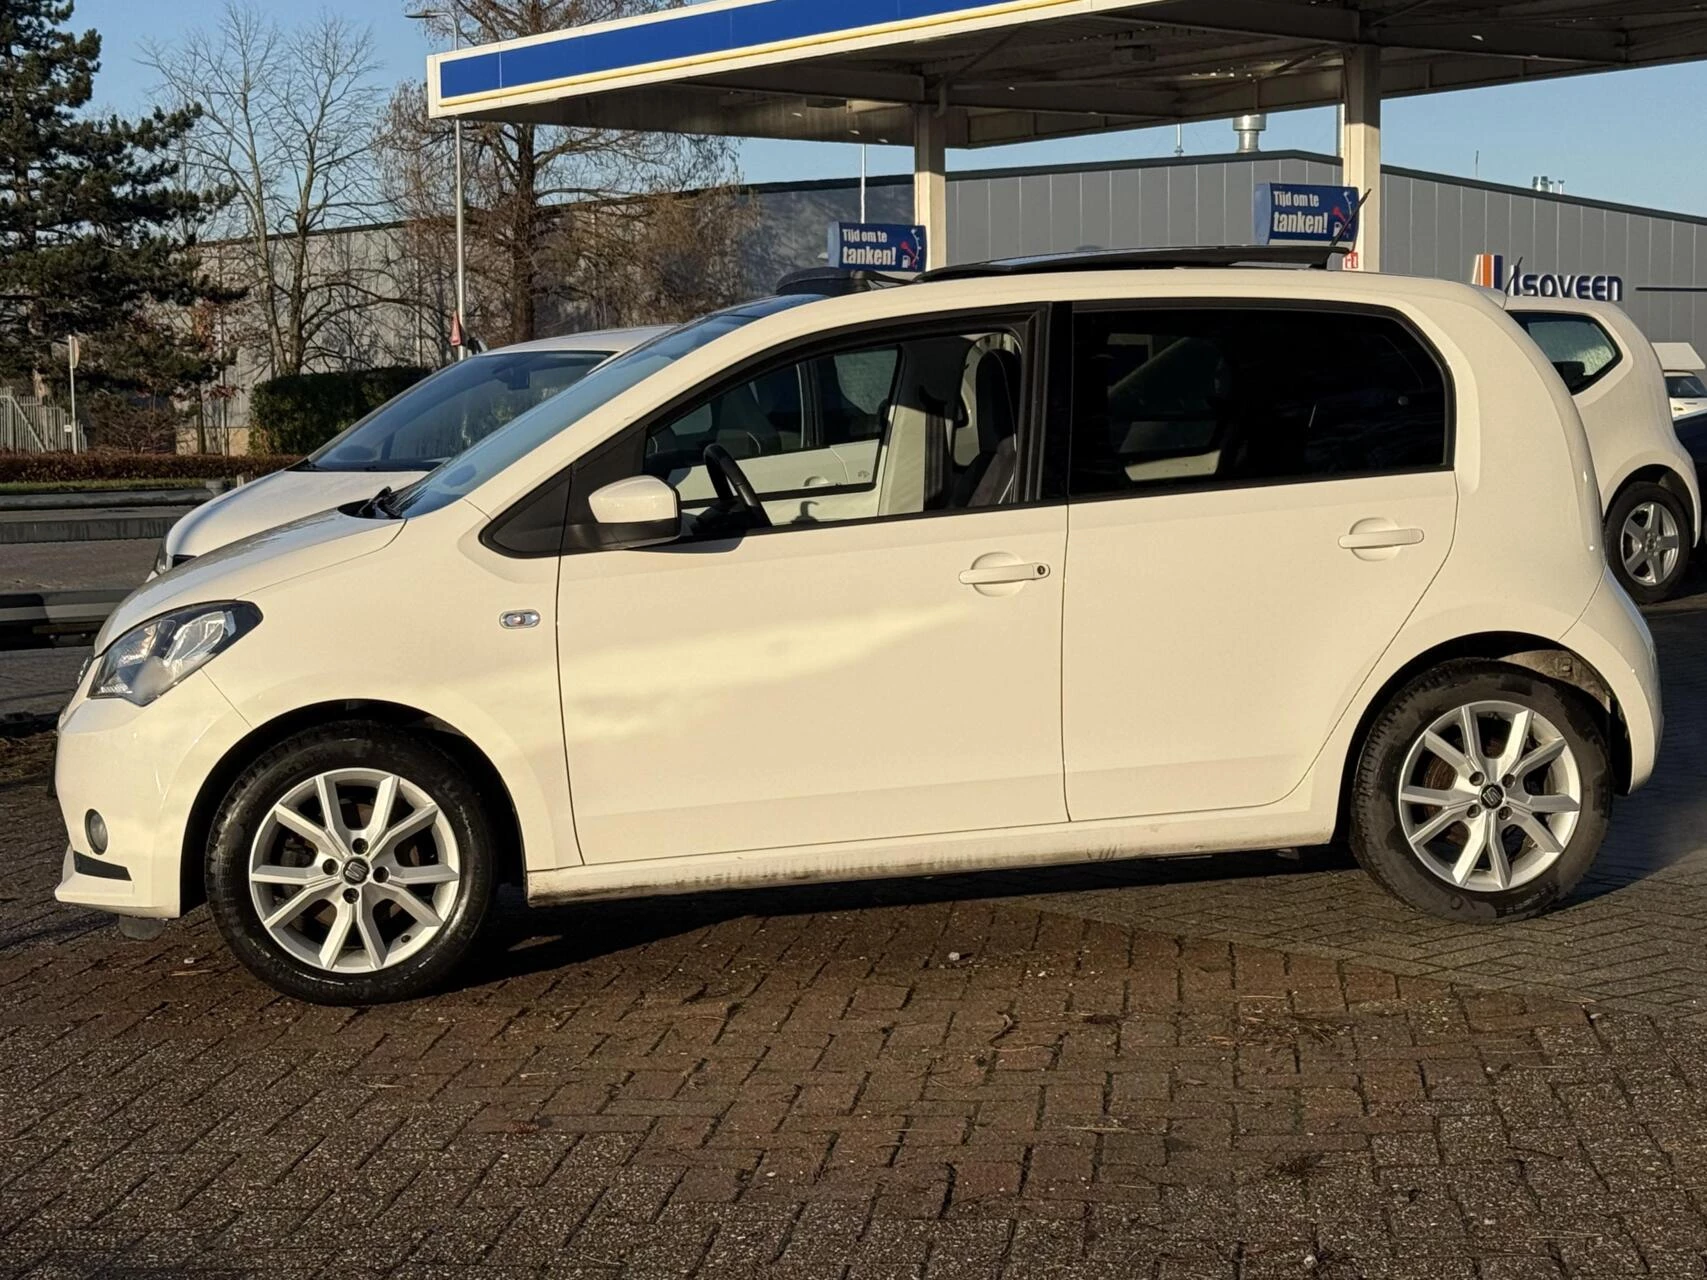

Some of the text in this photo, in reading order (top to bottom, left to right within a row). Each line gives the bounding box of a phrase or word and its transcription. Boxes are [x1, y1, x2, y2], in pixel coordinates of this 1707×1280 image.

[1273, 191, 1320, 207] Tijd om te
[1273, 211, 1328, 234] tanken!
[842, 228, 888, 243] Tijd om te
[842, 246, 897, 266] tanken!
